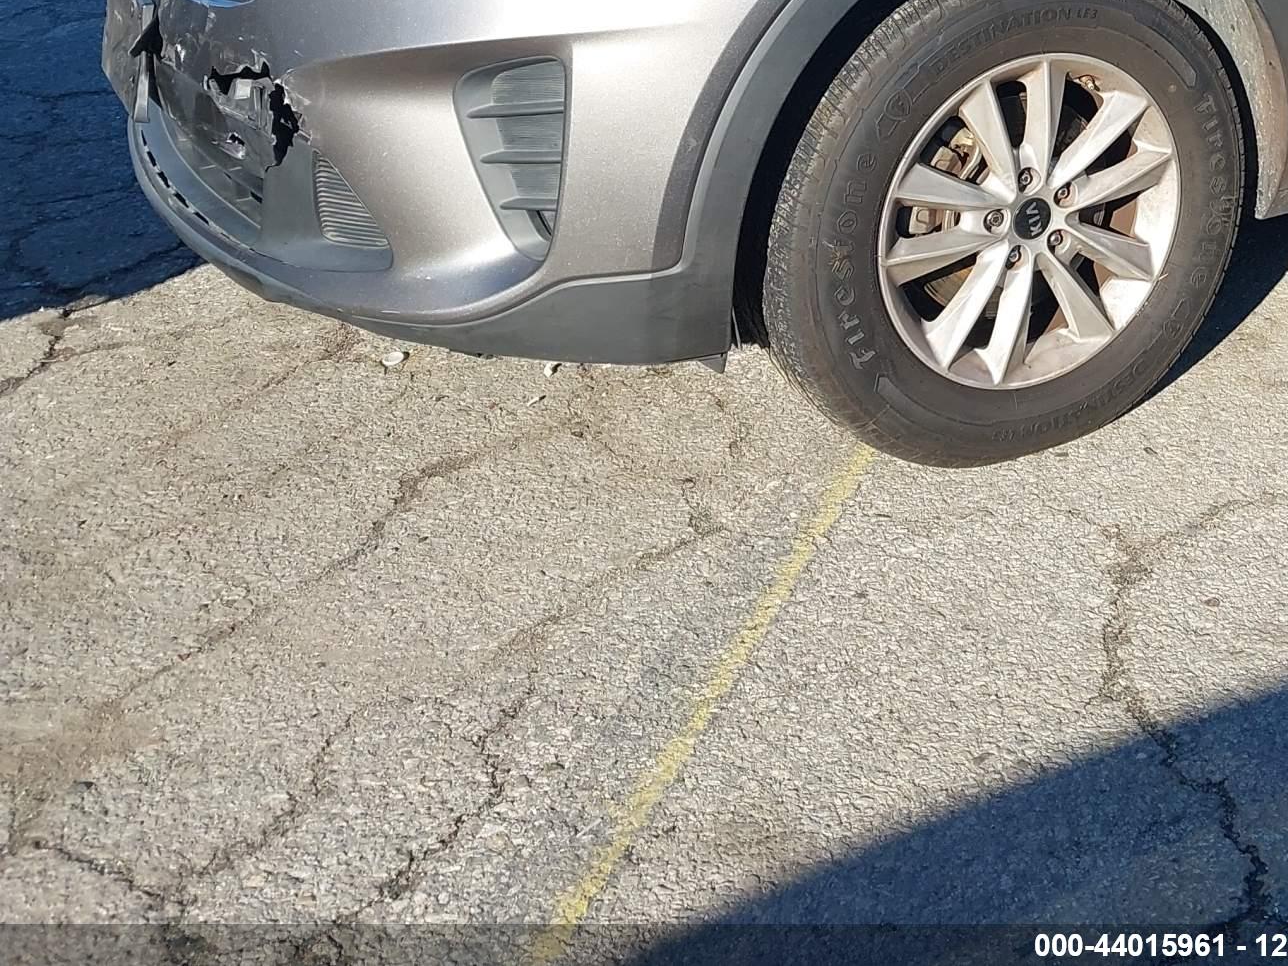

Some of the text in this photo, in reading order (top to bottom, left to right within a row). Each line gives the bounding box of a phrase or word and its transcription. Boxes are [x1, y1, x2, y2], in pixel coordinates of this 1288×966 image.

[931, 8, 1072, 76] DESTINATION
[1025, 201, 1042, 237] KIA
[1190, 93, 1233, 290] Firestone
[831, 153, 877, 370] Firestone
